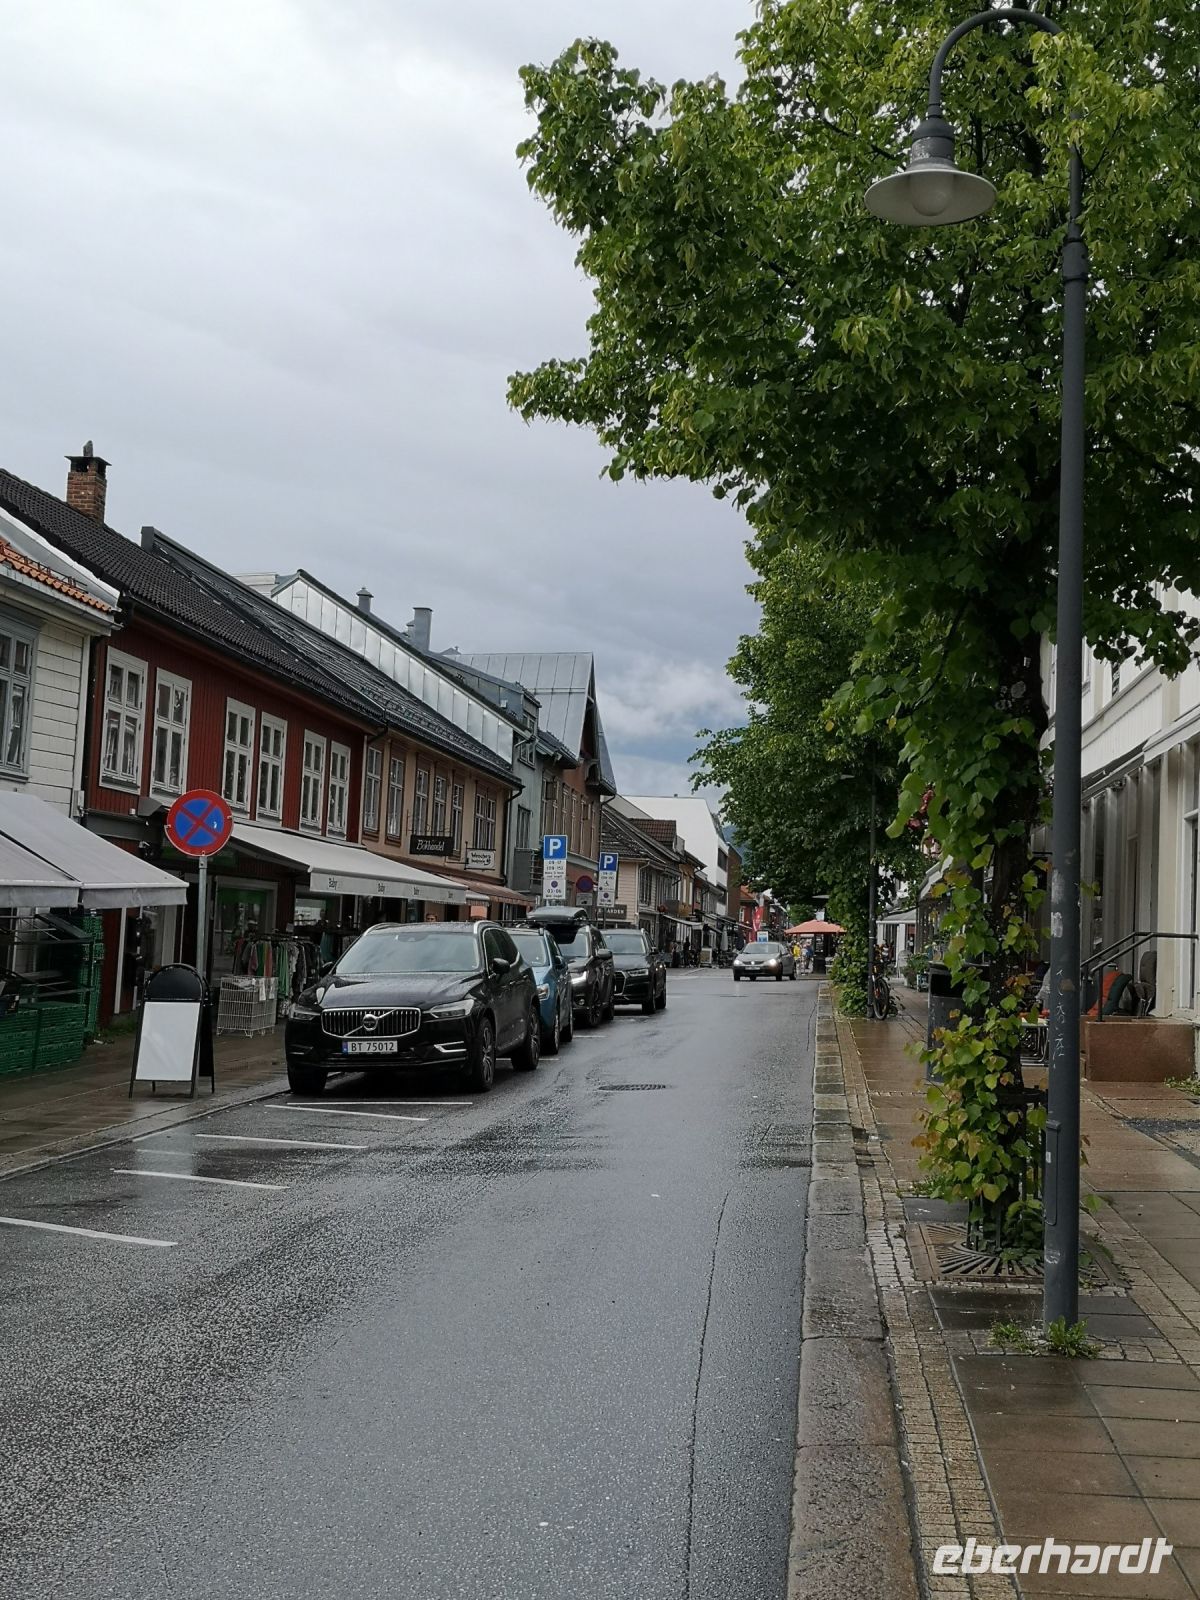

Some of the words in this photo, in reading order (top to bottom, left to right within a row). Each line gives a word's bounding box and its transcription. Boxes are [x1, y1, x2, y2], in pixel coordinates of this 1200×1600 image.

[549, 838, 562, 857] P
[604, 855, 614, 869] P
[351, 1042, 363, 1052] BT
[366, 1041, 394, 1052] 75012
